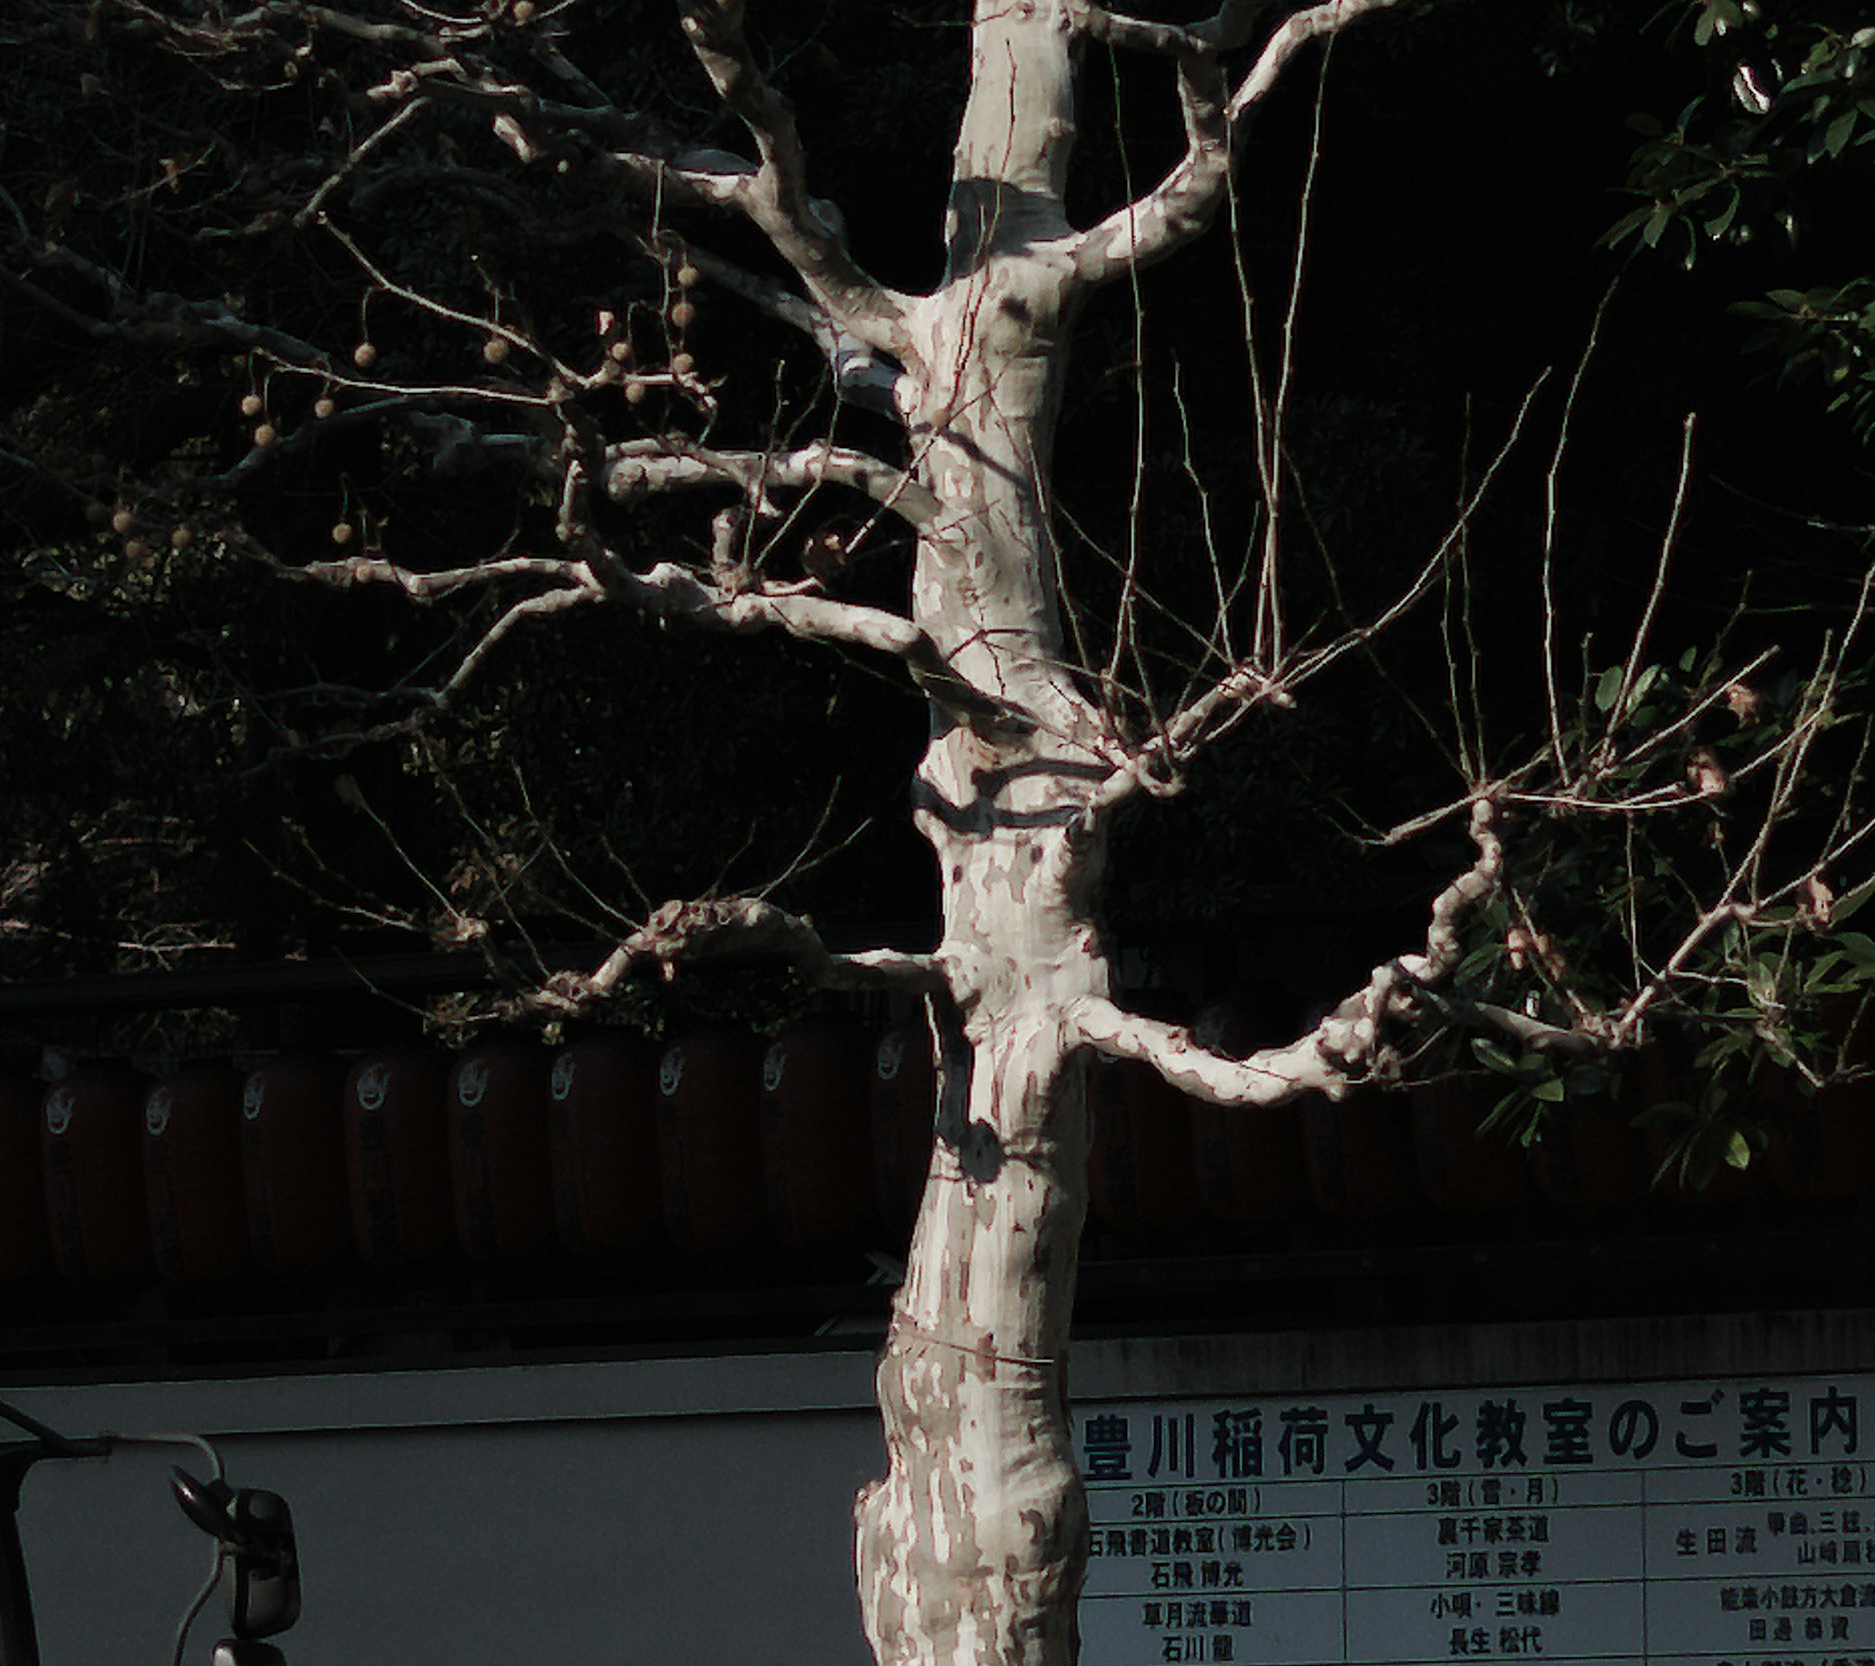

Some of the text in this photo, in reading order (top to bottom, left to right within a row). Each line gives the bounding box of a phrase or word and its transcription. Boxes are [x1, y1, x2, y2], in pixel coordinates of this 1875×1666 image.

[1082, 1385, 1858, 1481] 豊川稲荷文化教室のご案内
[1438, 1515, 1548, 1545] 裏千家茶道
[1676, 1527, 1757, 1555] 生田流
[1162, 1635, 1205, 1663] 石川
